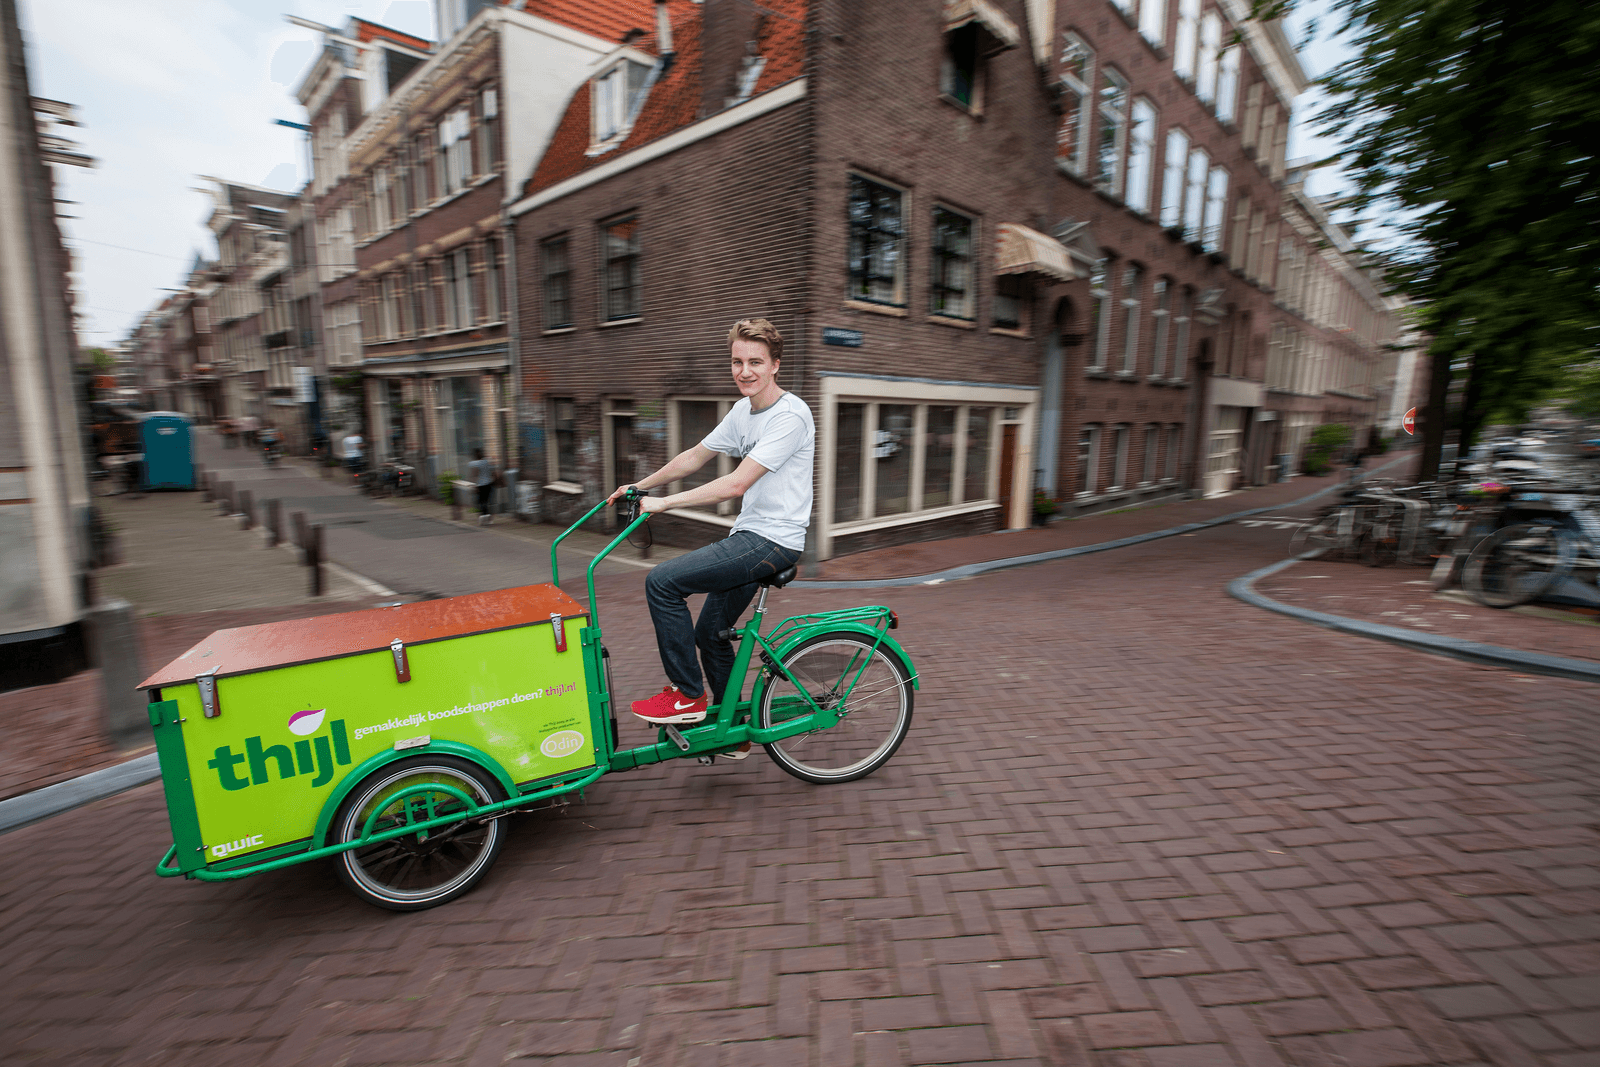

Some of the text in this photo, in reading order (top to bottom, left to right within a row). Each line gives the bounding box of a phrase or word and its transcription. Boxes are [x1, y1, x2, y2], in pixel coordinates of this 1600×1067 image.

[354, 681, 577, 740] gemakkelijk boodschappen doen? thijl.nl
[207, 719, 352, 791] thijl
[545, 736, 579, 753] Odin
